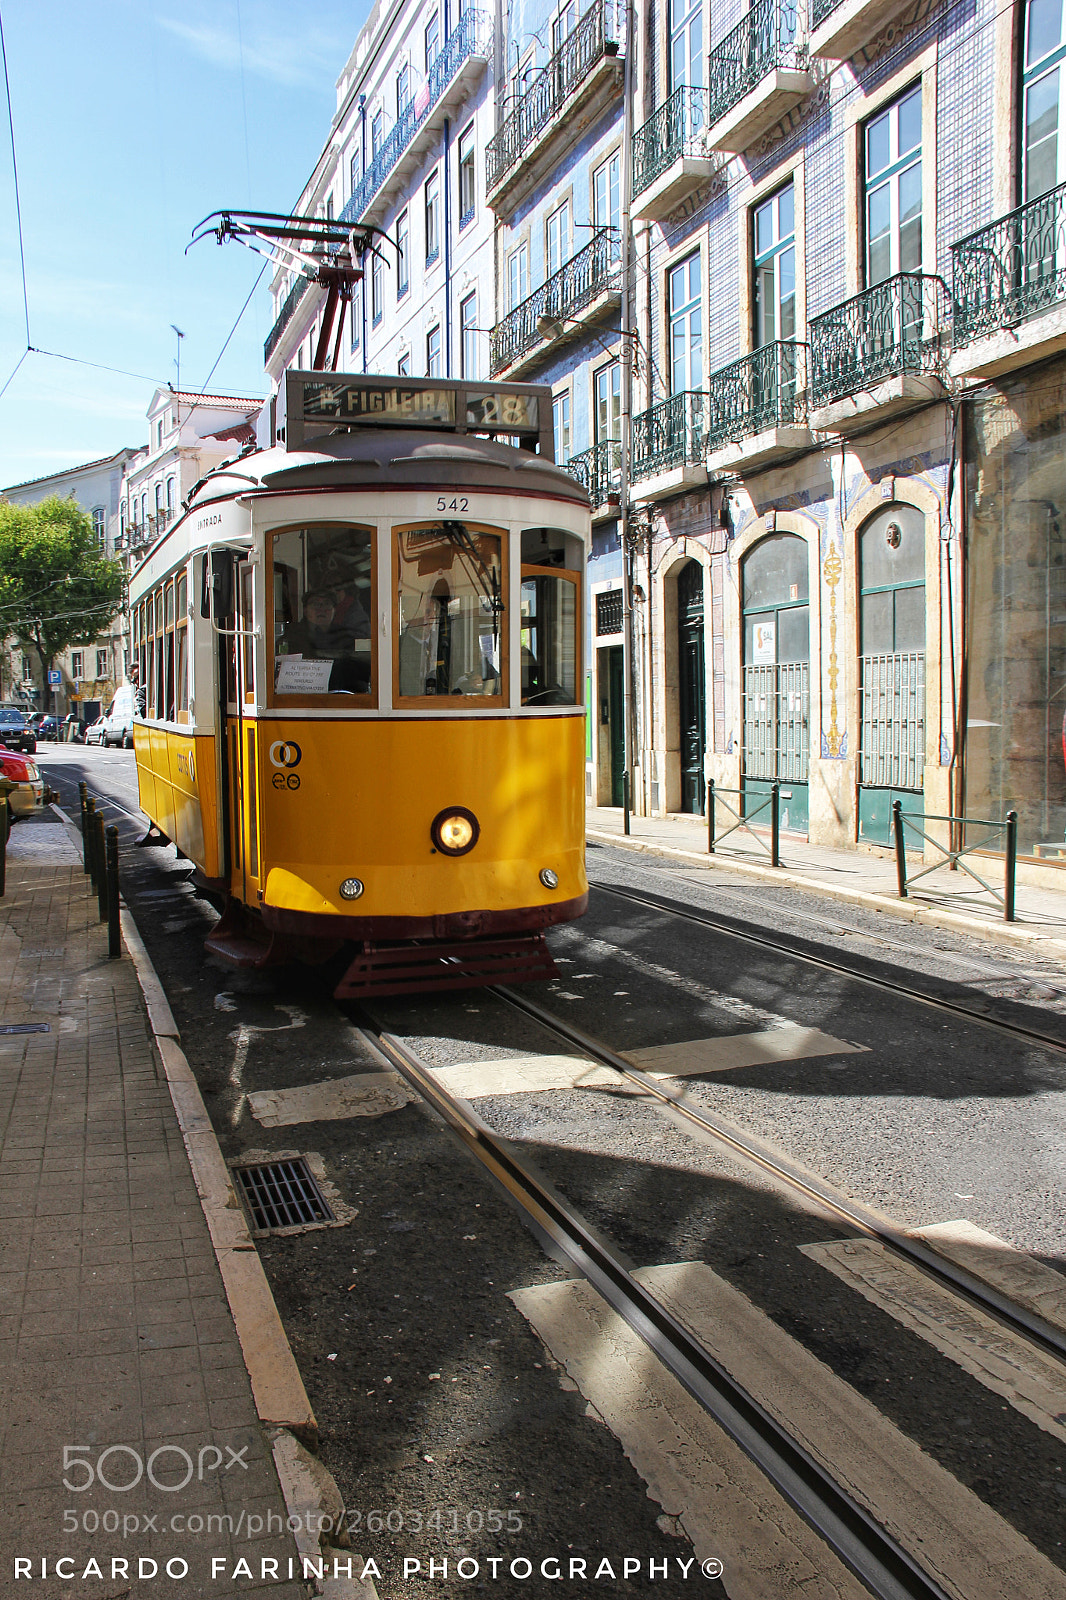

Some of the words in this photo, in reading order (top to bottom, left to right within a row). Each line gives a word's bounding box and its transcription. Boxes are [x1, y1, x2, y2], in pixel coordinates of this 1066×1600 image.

[347, 390, 450, 412] FIGUEIRA
[481, 396, 523, 425] 28
[436, 497, 469, 512] 542
[50, 672, 60, 683] P
